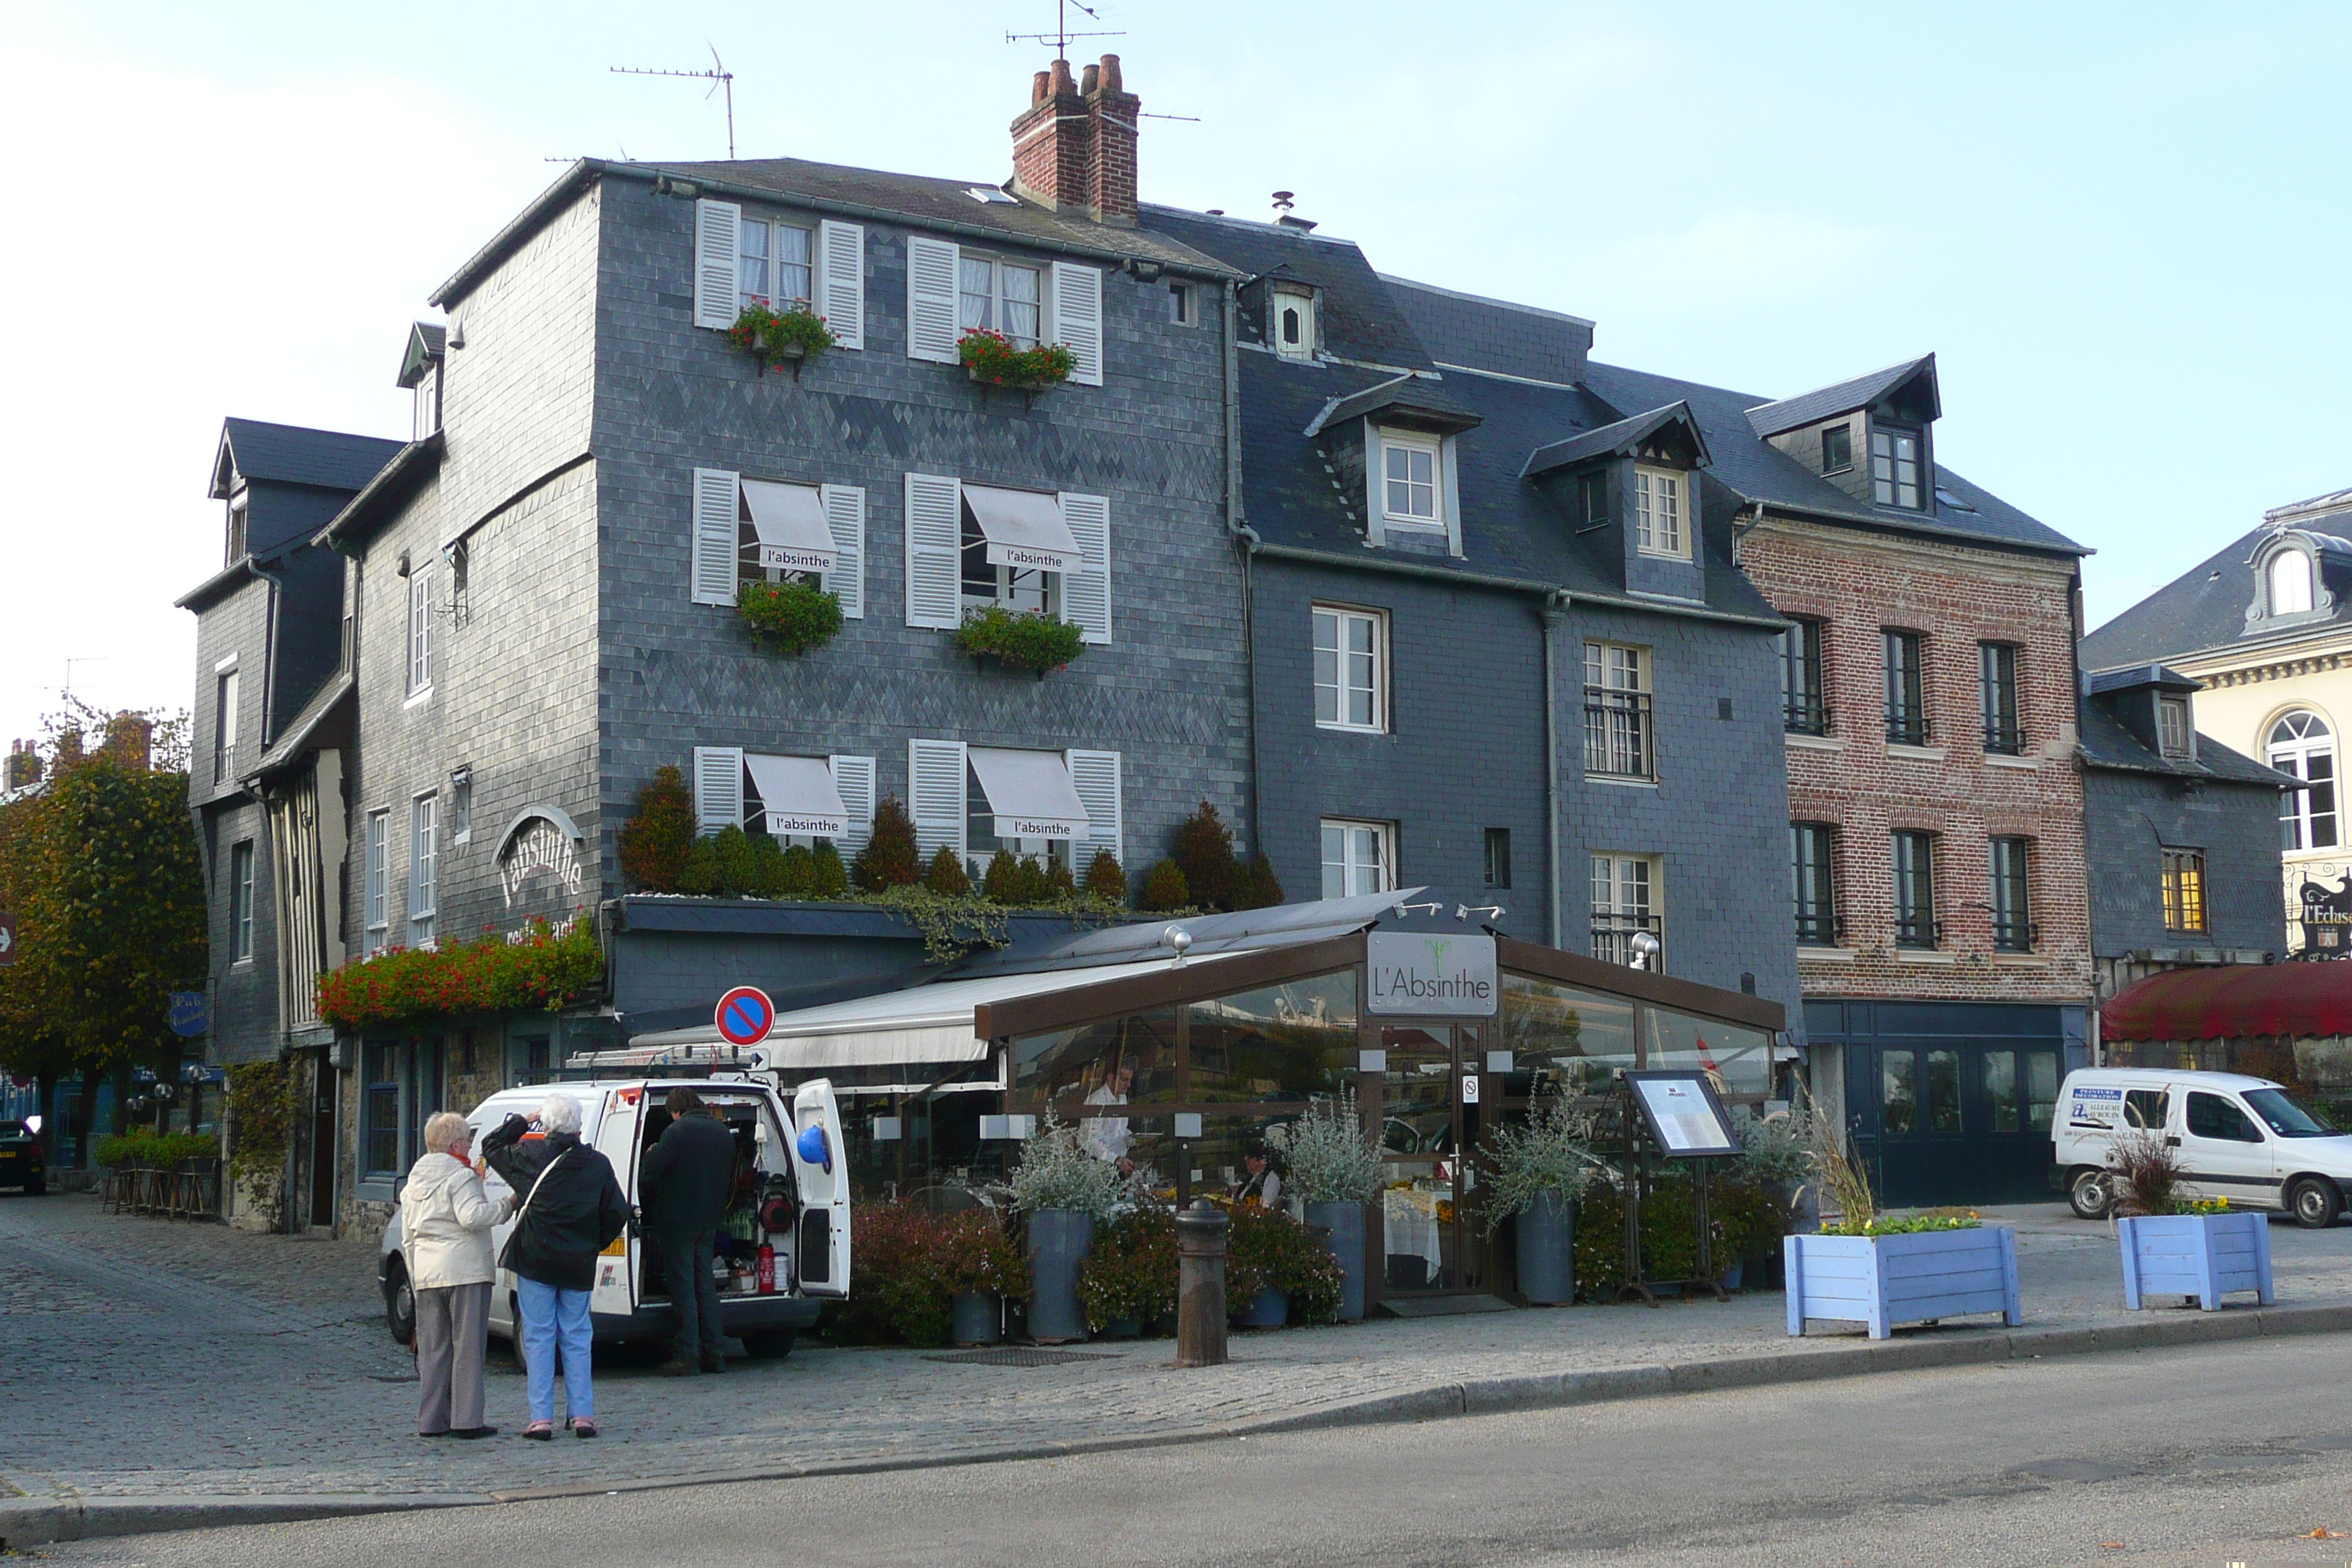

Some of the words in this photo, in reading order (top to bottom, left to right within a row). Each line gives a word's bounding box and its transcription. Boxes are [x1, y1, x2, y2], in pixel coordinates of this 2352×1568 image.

[768, 550, 829, 568] l'absinthe
[1008, 549, 1063, 567] l'absinthe
[777, 817, 839, 832] l'absinthe
[1014, 821, 1071, 834] l'absinthe
[1375, 967, 1490, 998] L'Absinthe
[176, 995, 201, 1006] Pub
